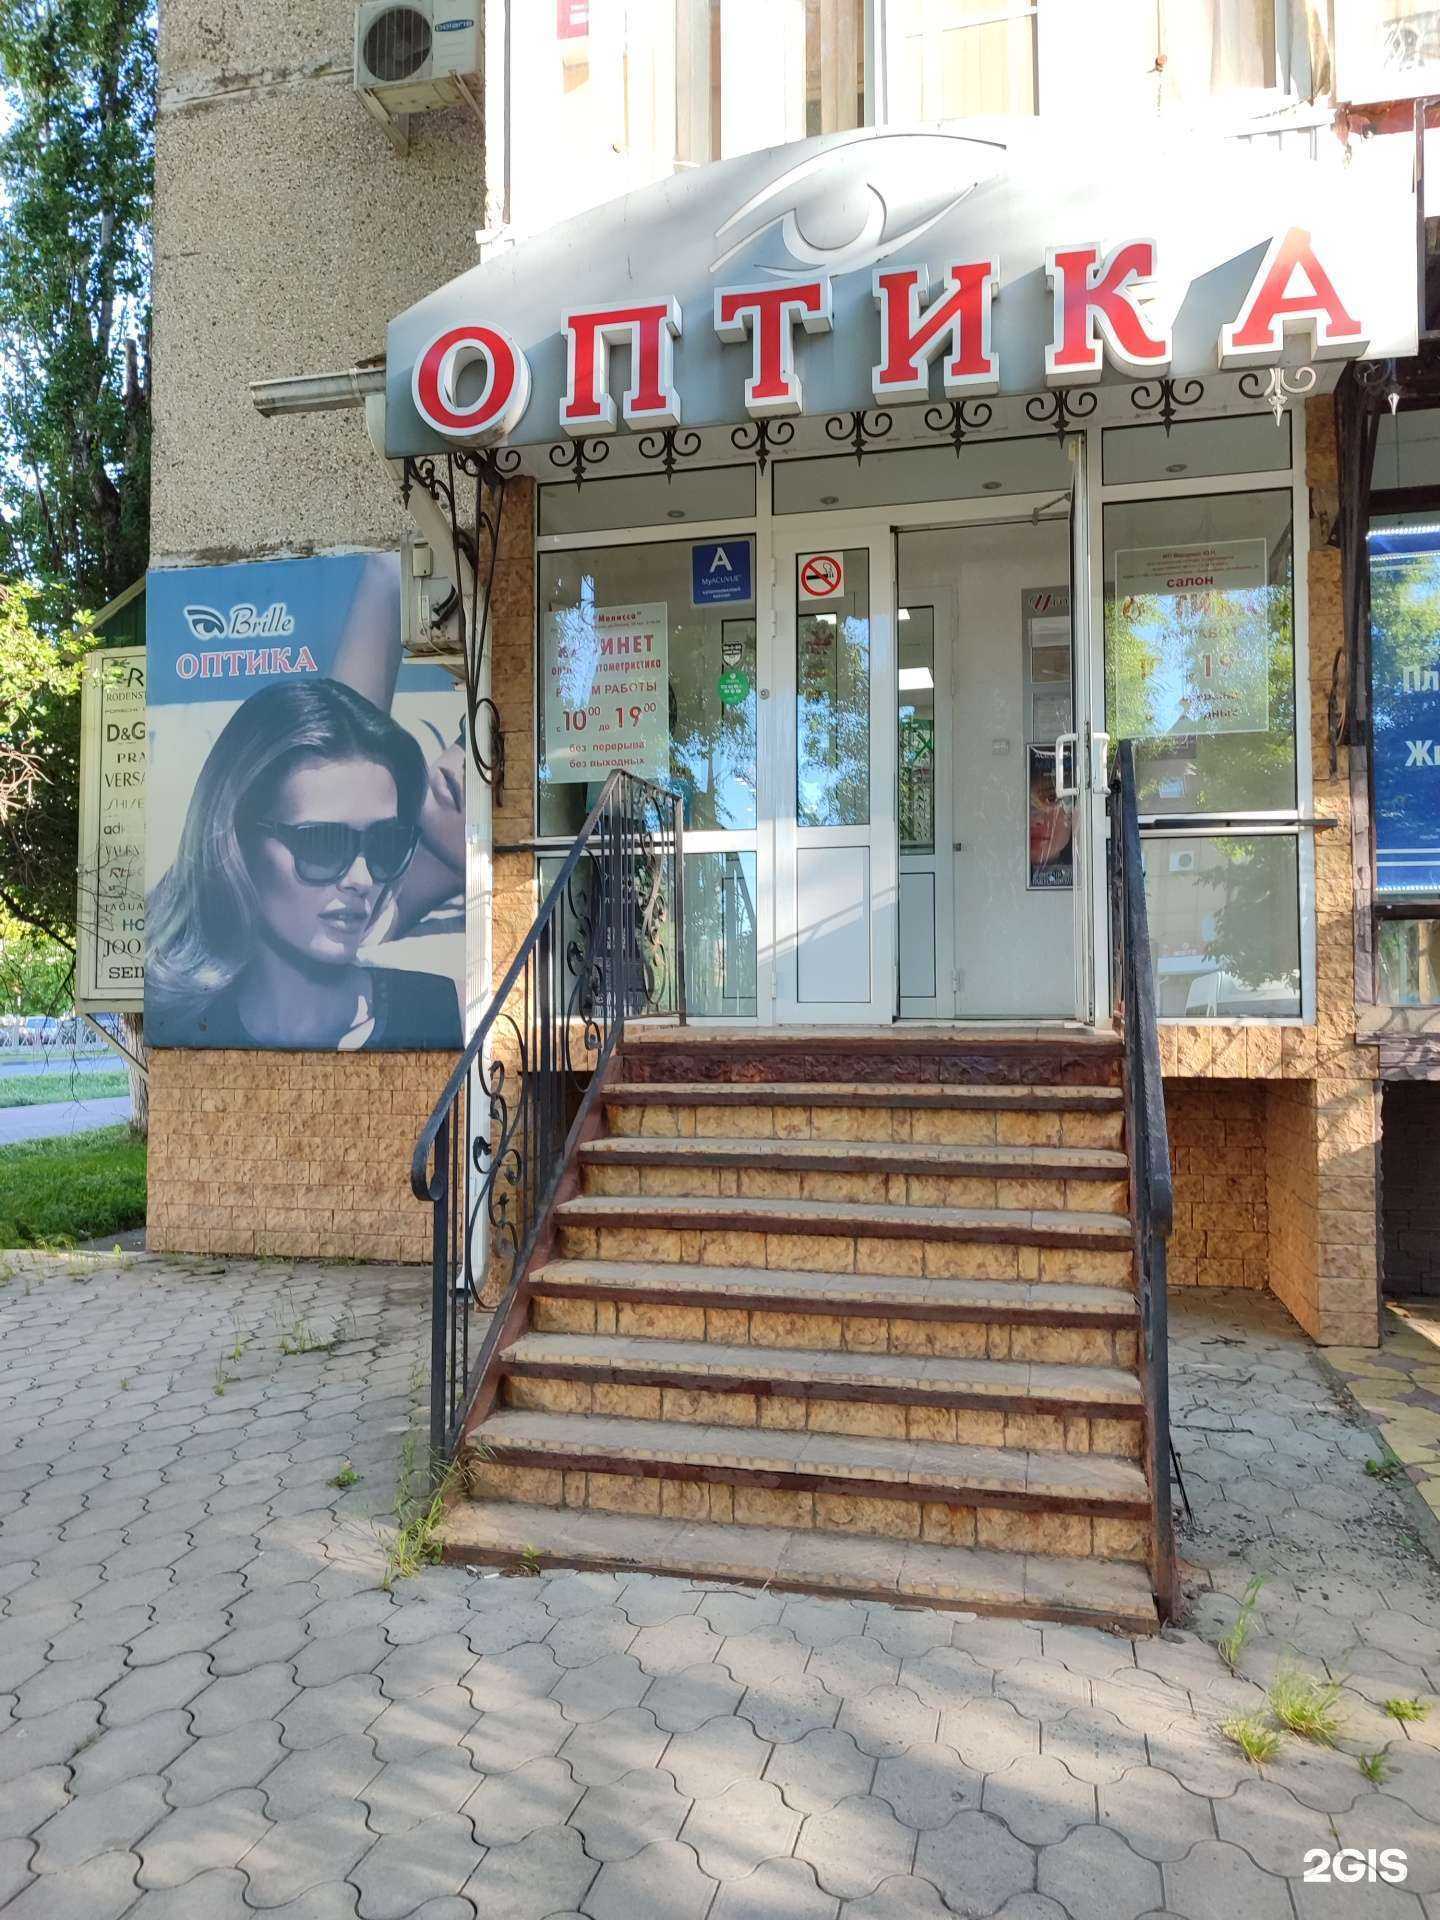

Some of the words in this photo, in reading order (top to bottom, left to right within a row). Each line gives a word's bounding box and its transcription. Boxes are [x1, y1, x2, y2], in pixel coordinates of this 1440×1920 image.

[410, 228, 1369, 446] ОПТИКА
[709, 547, 732, 573] A
[1166, 576, 1214, 588] салон
[230, 604, 293, 636] Brille
[175, 646, 319, 679] ОПТИКА
[604, 682, 657, 694] РАБОТЫ
[106, 722, 146, 742] D&G
